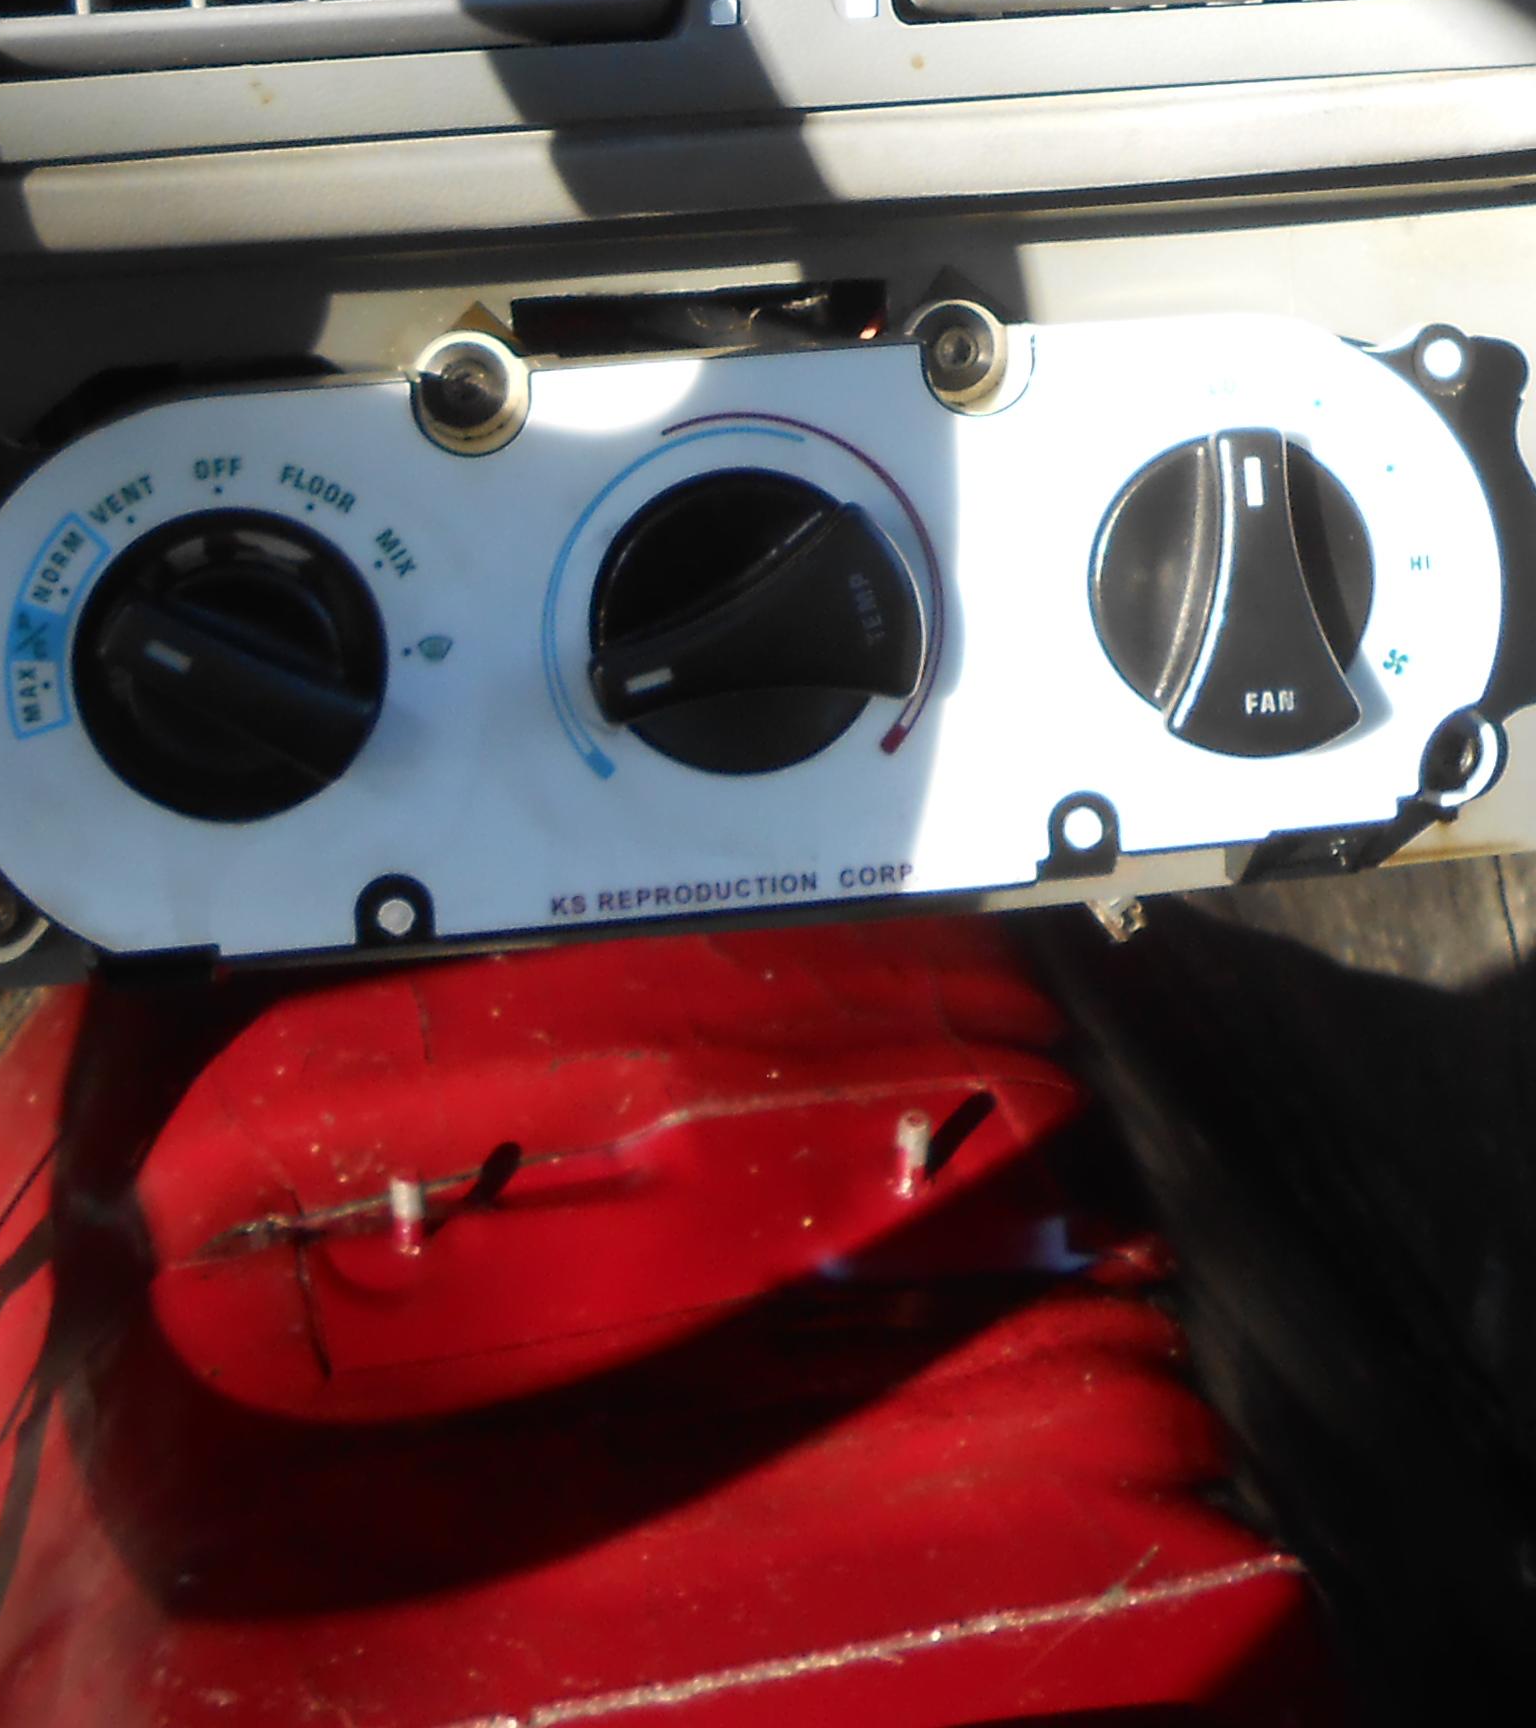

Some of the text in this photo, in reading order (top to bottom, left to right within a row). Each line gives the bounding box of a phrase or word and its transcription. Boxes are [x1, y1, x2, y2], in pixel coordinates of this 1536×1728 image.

[193, 456, 242, 481] OFF
[279, 463, 357, 514] FLOOR
[87, 474, 155, 525] VENT
[374, 527, 416, 578] MIX
[1409, 554, 1431, 571] HI
[19, 668, 42, 724] MAX
[31, 530, 85, 603] NORM
[1244, 690, 1296, 714] FAN
[550, 863, 914, 917] KS REPRODUCTION CORP
